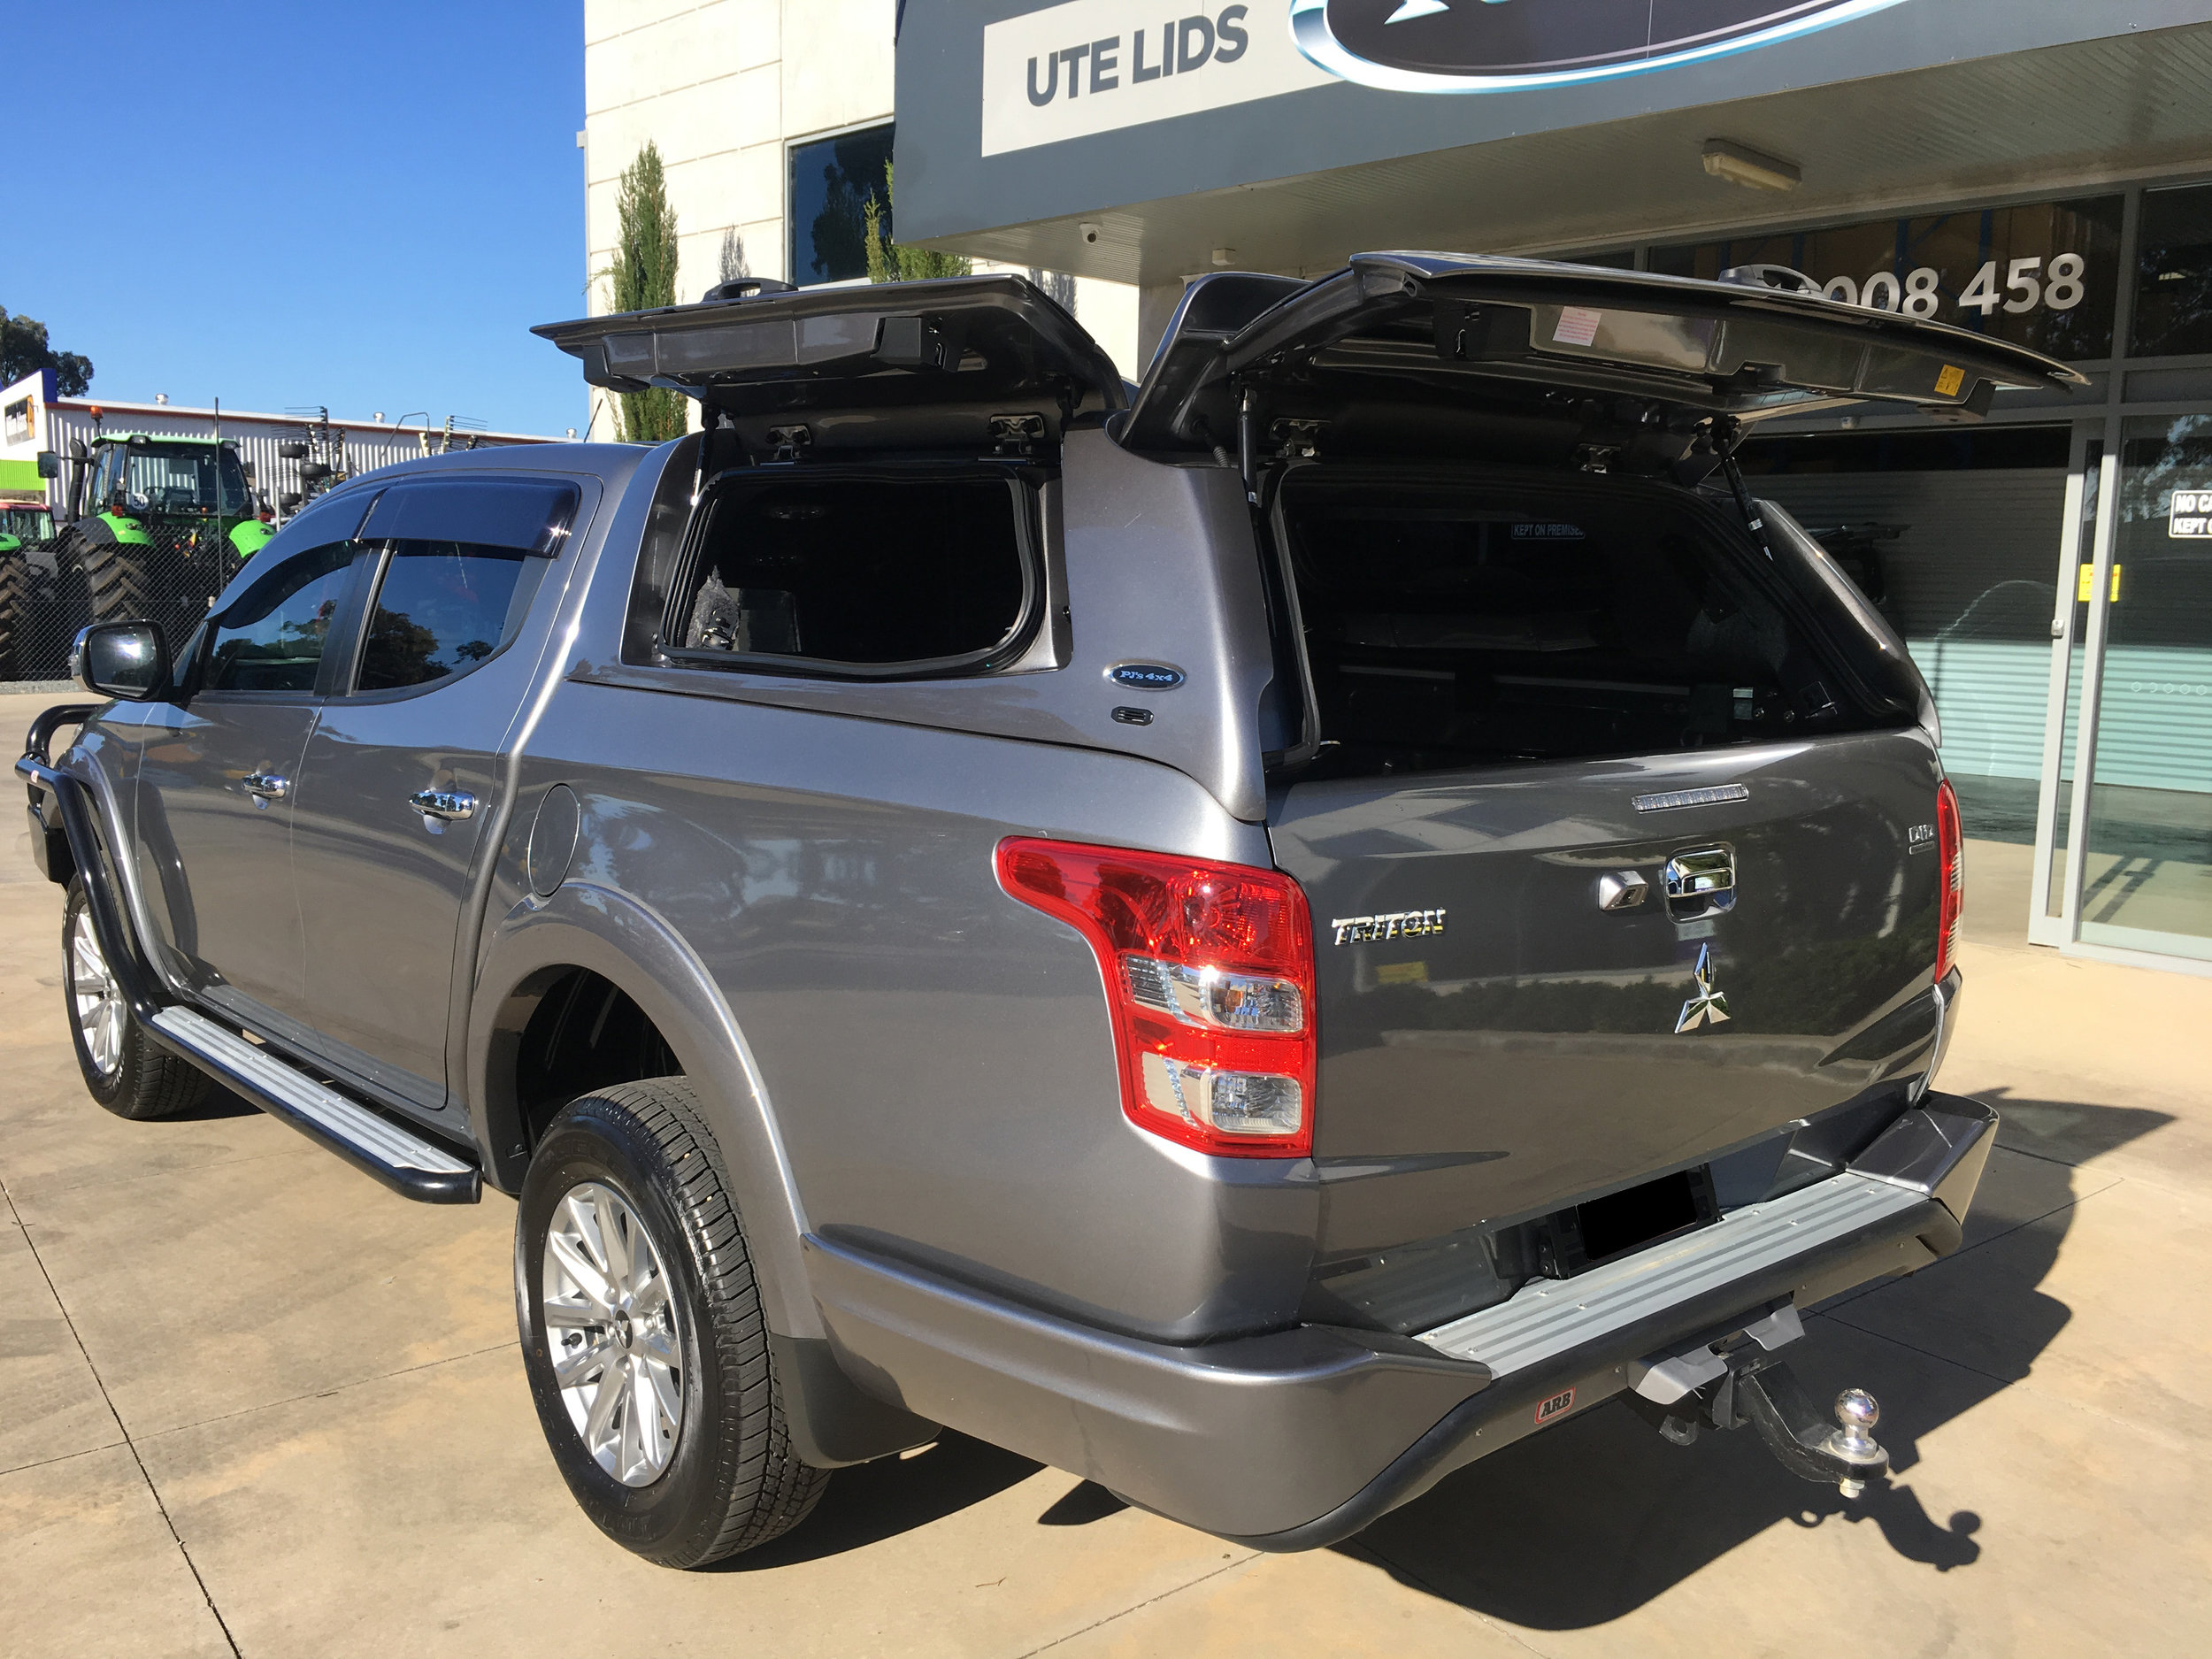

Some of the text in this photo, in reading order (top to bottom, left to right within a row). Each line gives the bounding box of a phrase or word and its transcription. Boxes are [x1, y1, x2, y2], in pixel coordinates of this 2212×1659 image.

[1027, 4, 1249, 107] UTE LIDS
[1958, 252, 2085, 315] 458
[134, 495, 145, 507] 50
[2175, 494, 2196, 513] NO
[1513, 523, 1533, 536] KEPT
[1534, 523, 1546, 536] ON
[2173, 517, 2207, 534] KEPT
[1119, 670, 1173, 682] PJ's 4x4
[1331, 908, 1447, 946] TRITON
[1540, 1392, 1571, 1418] ARB
